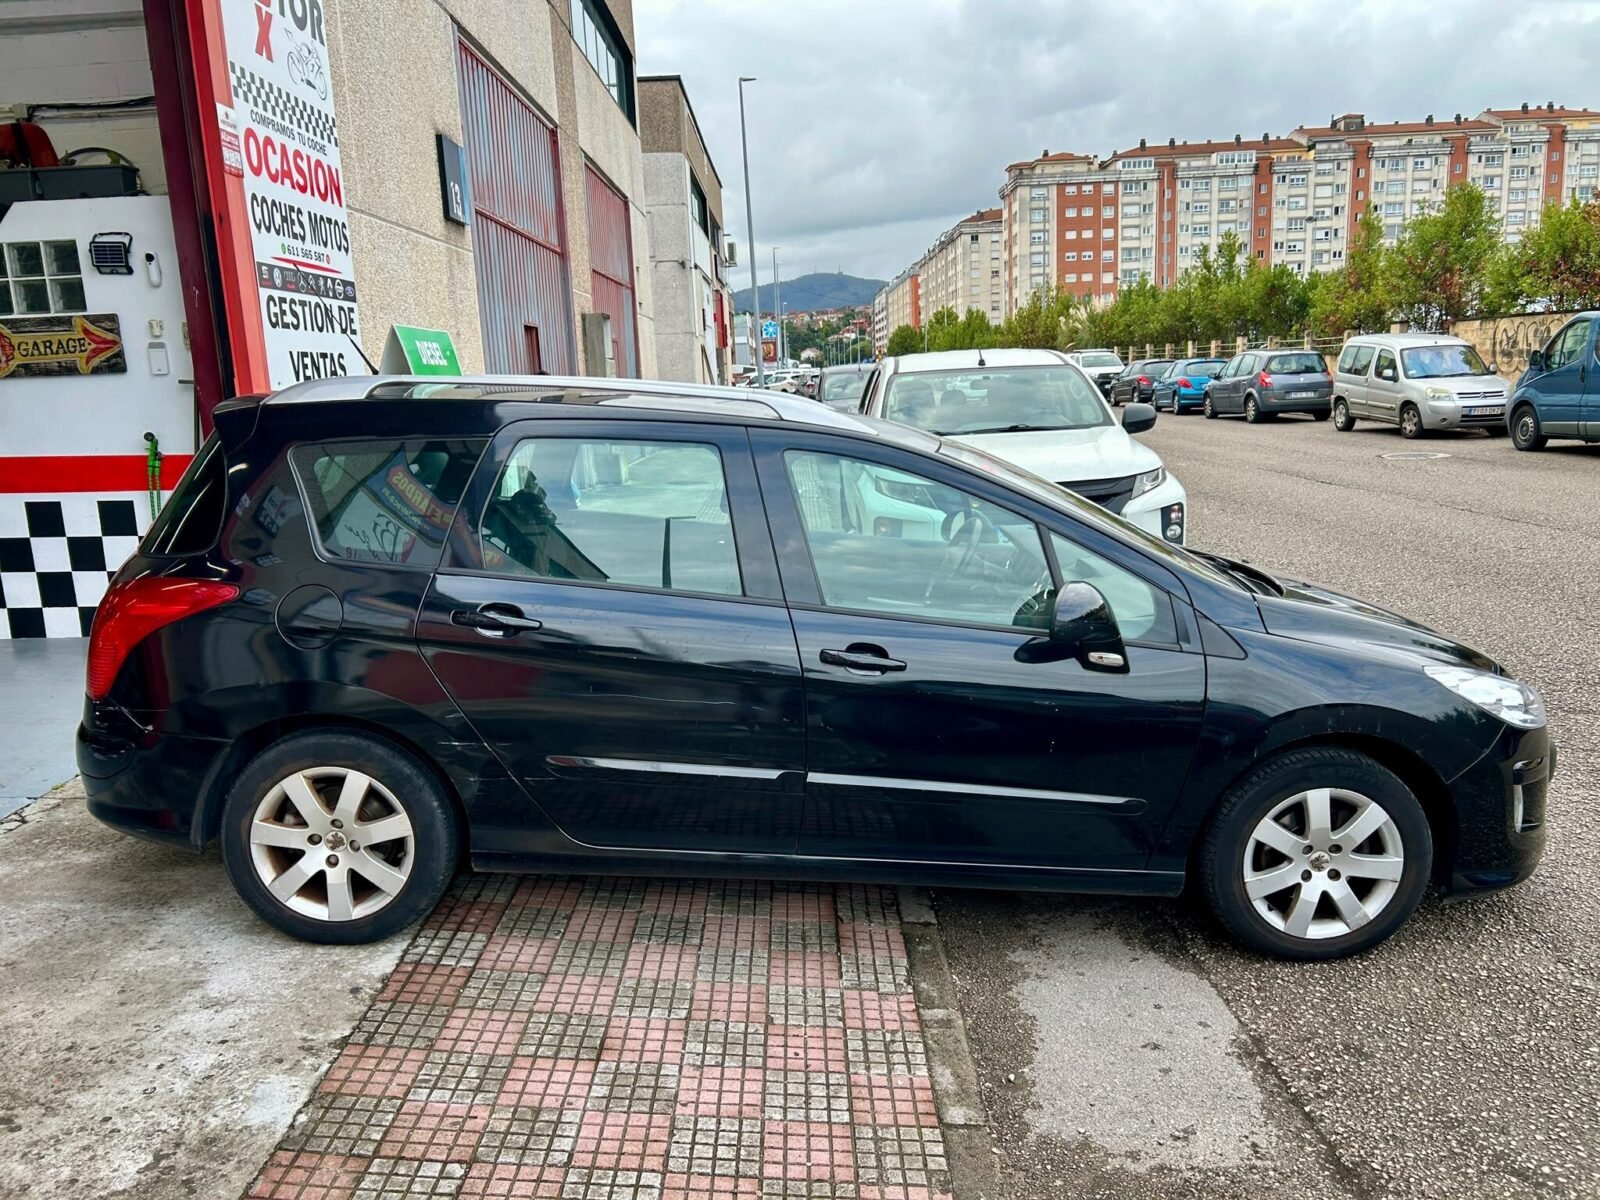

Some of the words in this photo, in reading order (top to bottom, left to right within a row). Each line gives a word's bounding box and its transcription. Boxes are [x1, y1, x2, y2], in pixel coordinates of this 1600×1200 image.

[250, 109, 296, 141] COMPRAMOS
[297, 131, 306, 147] TU
[307, 136, 328, 156] COCHE
[243, 127, 343, 208] OCASION
[450, 181, 463, 221] 13
[250, 192, 306, 245] COCHES
[307, 210, 350, 256] MOTOS
[286, 244, 300, 257] 611
[301, 248, 313, 260] 565
[314, 251, 325, 262] 587
[266, 294, 336, 334] GESTION
[338, 305, 357, 335] DE
[17, 337, 88, 357] GARAGE
[288, 350, 347, 382] VENTAS
[415, 340, 448, 366] DIESEL
